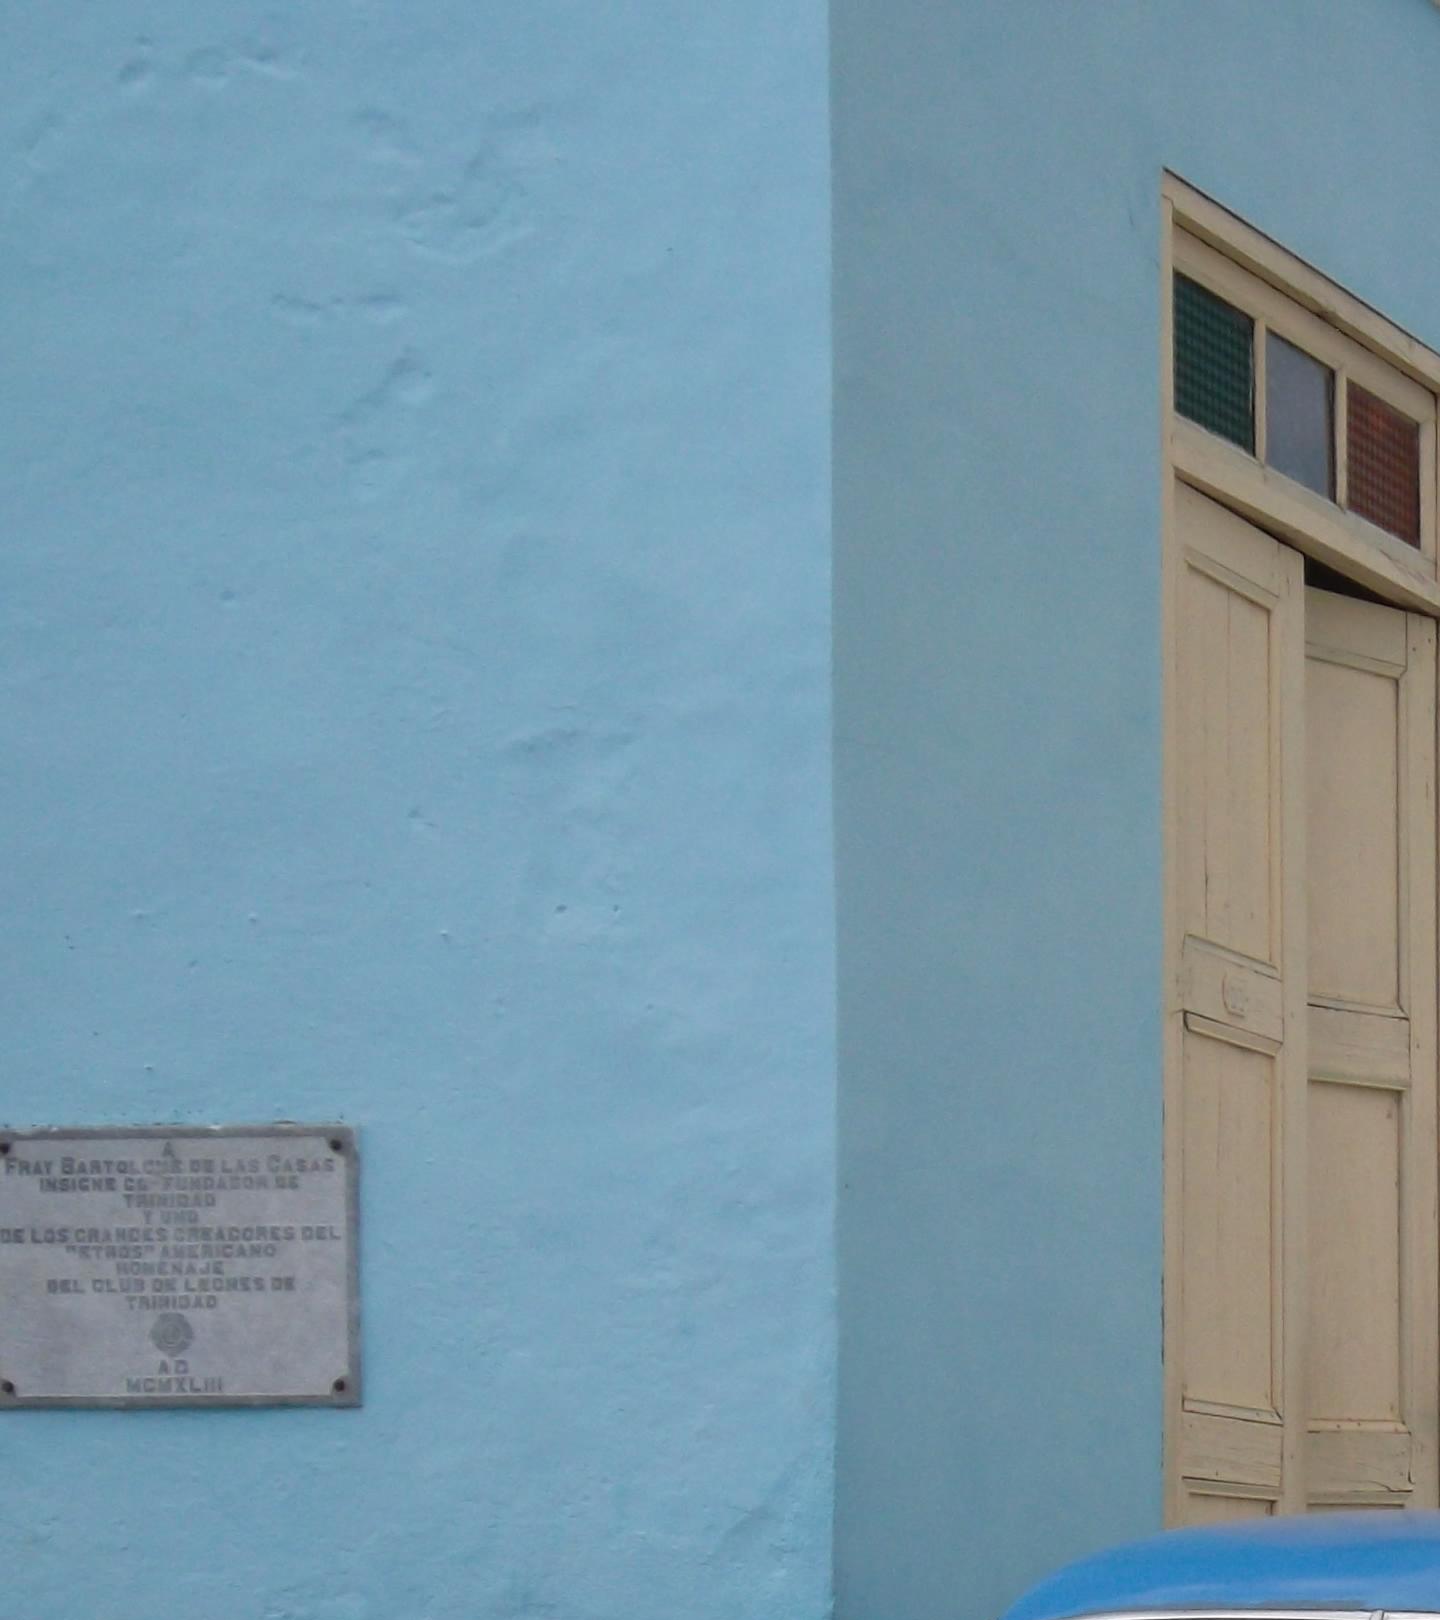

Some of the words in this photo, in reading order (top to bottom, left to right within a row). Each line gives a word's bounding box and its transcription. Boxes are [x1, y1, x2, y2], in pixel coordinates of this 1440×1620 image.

[162, 1142, 176, 1158] A
[189, 1158, 215, 1173] DE
[221, 1157, 260, 1173] LAS
[122, 1193, 217, 1208] TRINIDAD
[0, 1228, 25, 1244] DE
[30, 1228, 69, 1243] LOS
[301, 1225, 342, 1241] DEL
[116, 1261, 225, 1276] HOMENAJE
[47, 1279, 85, 1294] DEL
[91, 1278, 145, 1293] CLUB
[270, 1275, 296, 1291] DE
[125, 1294, 218, 1310] TRINIDAD
